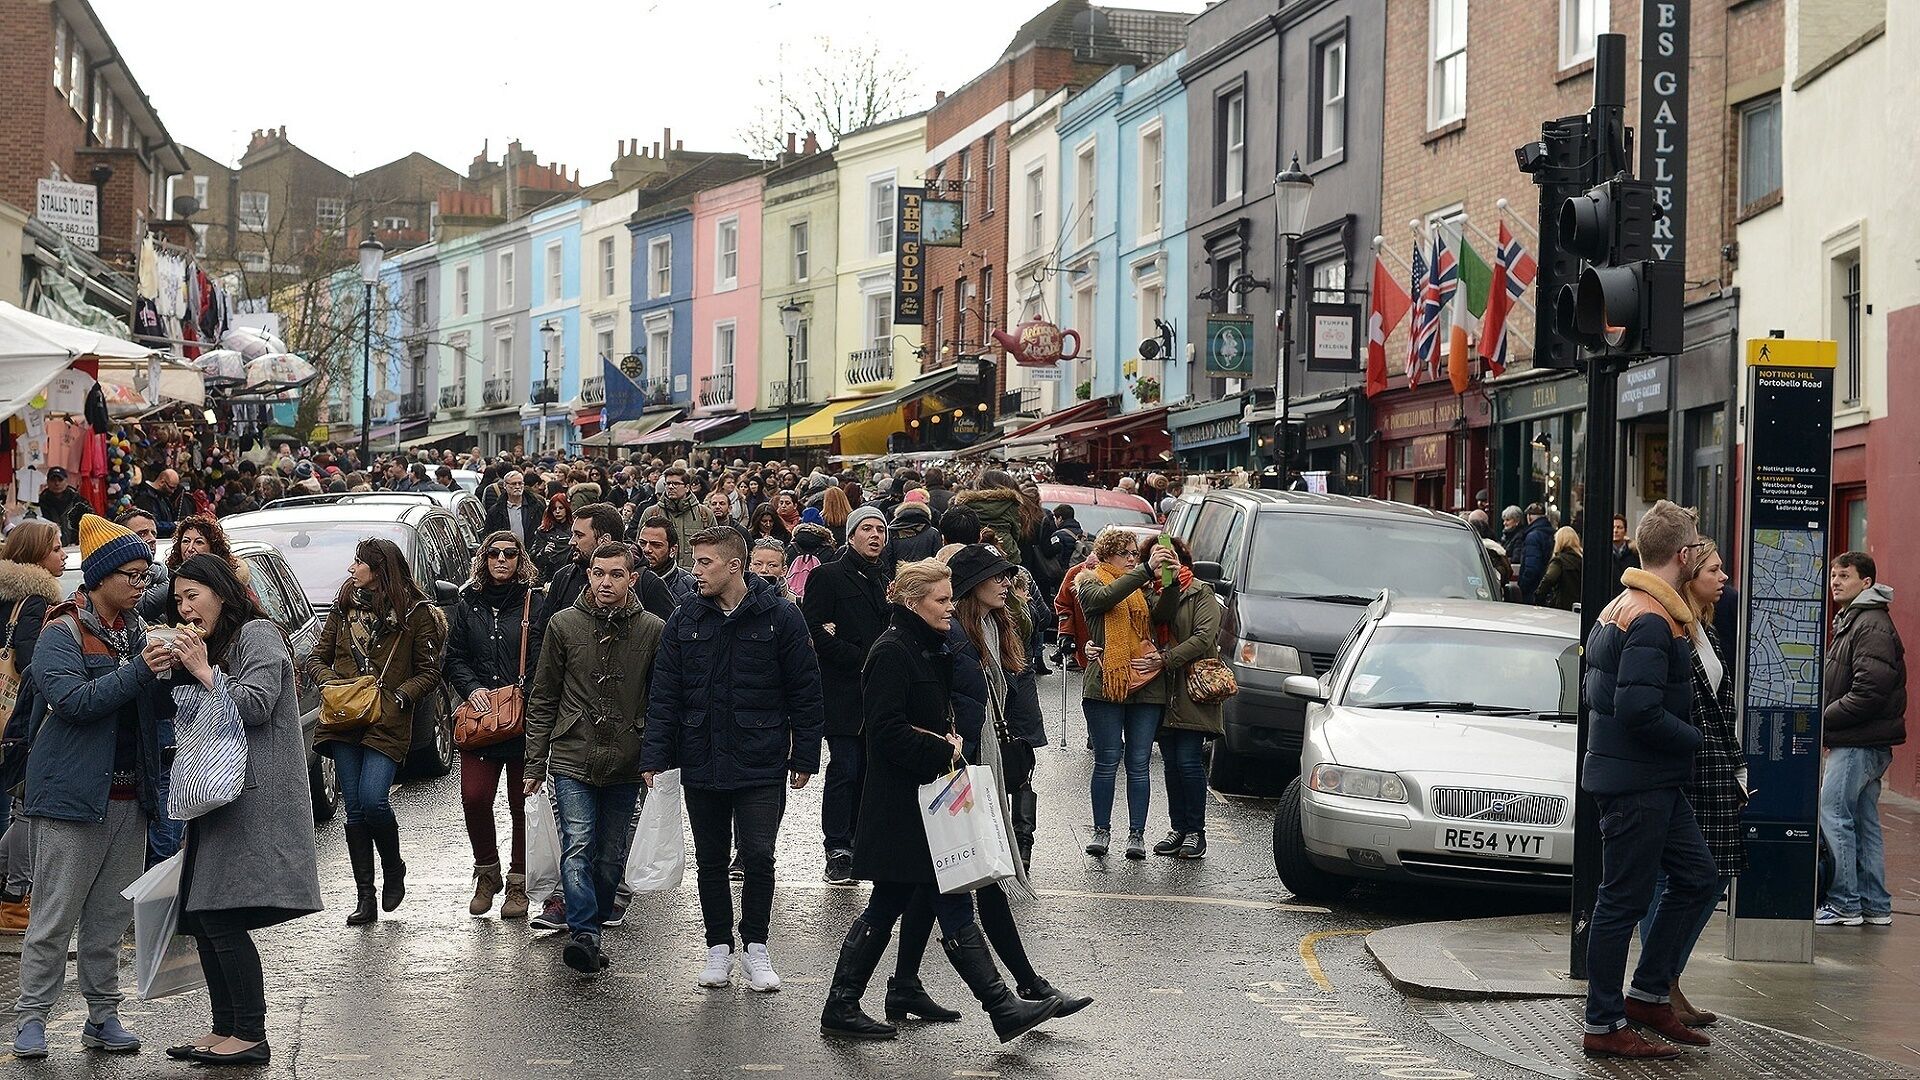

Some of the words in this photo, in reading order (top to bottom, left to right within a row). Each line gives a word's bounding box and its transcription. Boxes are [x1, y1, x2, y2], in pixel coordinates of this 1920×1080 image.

[1657, 3, 1676, 56] ES
[1652, 71, 1677, 260] GALLERY
[41, 194, 67, 213] STALLS
[70, 197, 79, 214] TO
[81, 199, 93, 216] LET
[903, 194, 920, 233] THE
[901, 241, 919, 293] GOLD
[1759, 370, 1796, 378] NOTTING
[1759, 378, 1801, 387] Portobello
[1802, 380, 1822, 388] Road
[1216, 418, 1239, 437] STORE
[1390, 410, 1419, 430] PORTOBELLO
[1762, 465, 1784, 473] Notting
[1444, 828, 1498, 851] RE54
[1505, 833, 1545, 854] YYT
[935, 847, 976, 869] OFFICE
